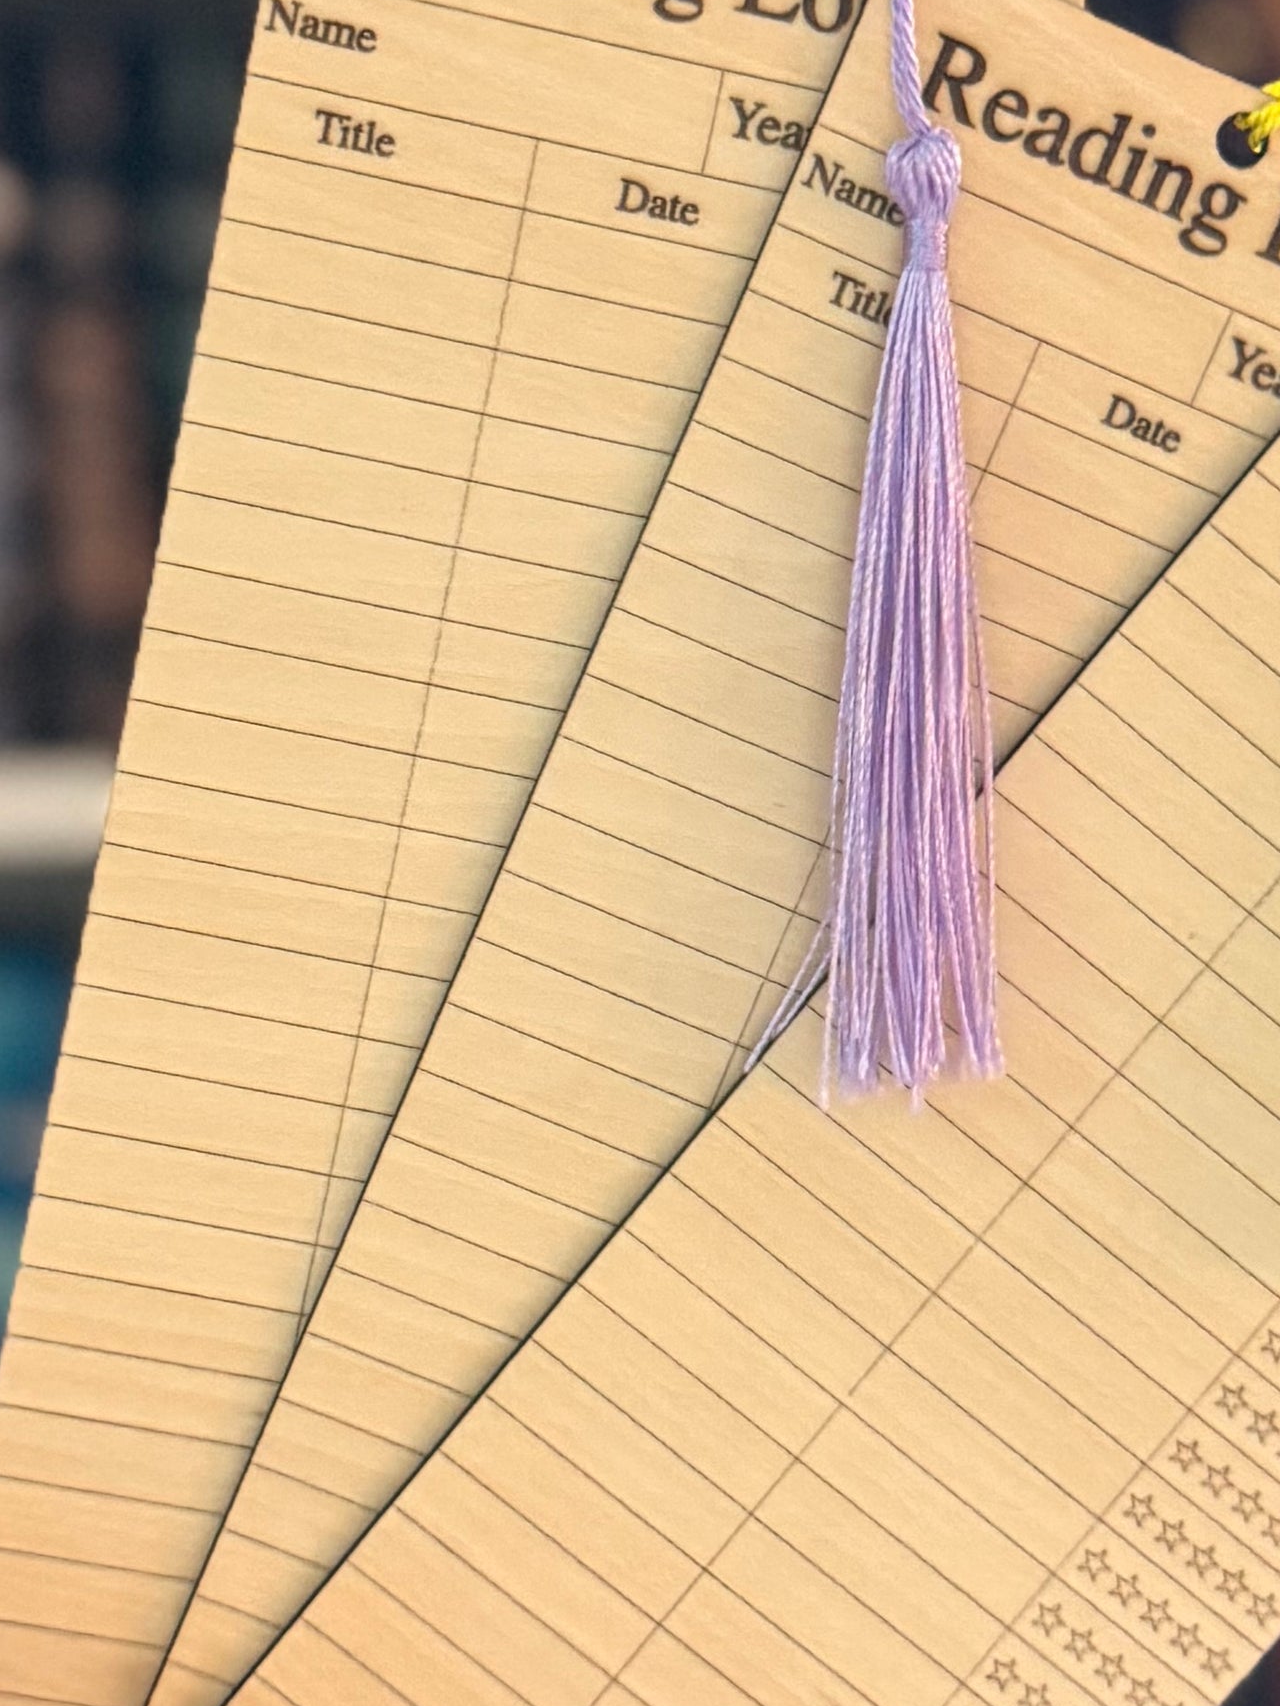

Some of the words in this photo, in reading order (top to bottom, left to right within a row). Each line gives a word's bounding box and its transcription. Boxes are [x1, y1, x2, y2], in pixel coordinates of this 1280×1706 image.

[315, 110, 396, 158] Title
[729, 96, 813, 152] Yea
[923, 31, 1248, 257] Reading
[618, 179, 700, 227] Date
[800, 153, 906, 227] Name
[1100, 394, 1181, 453] Date
